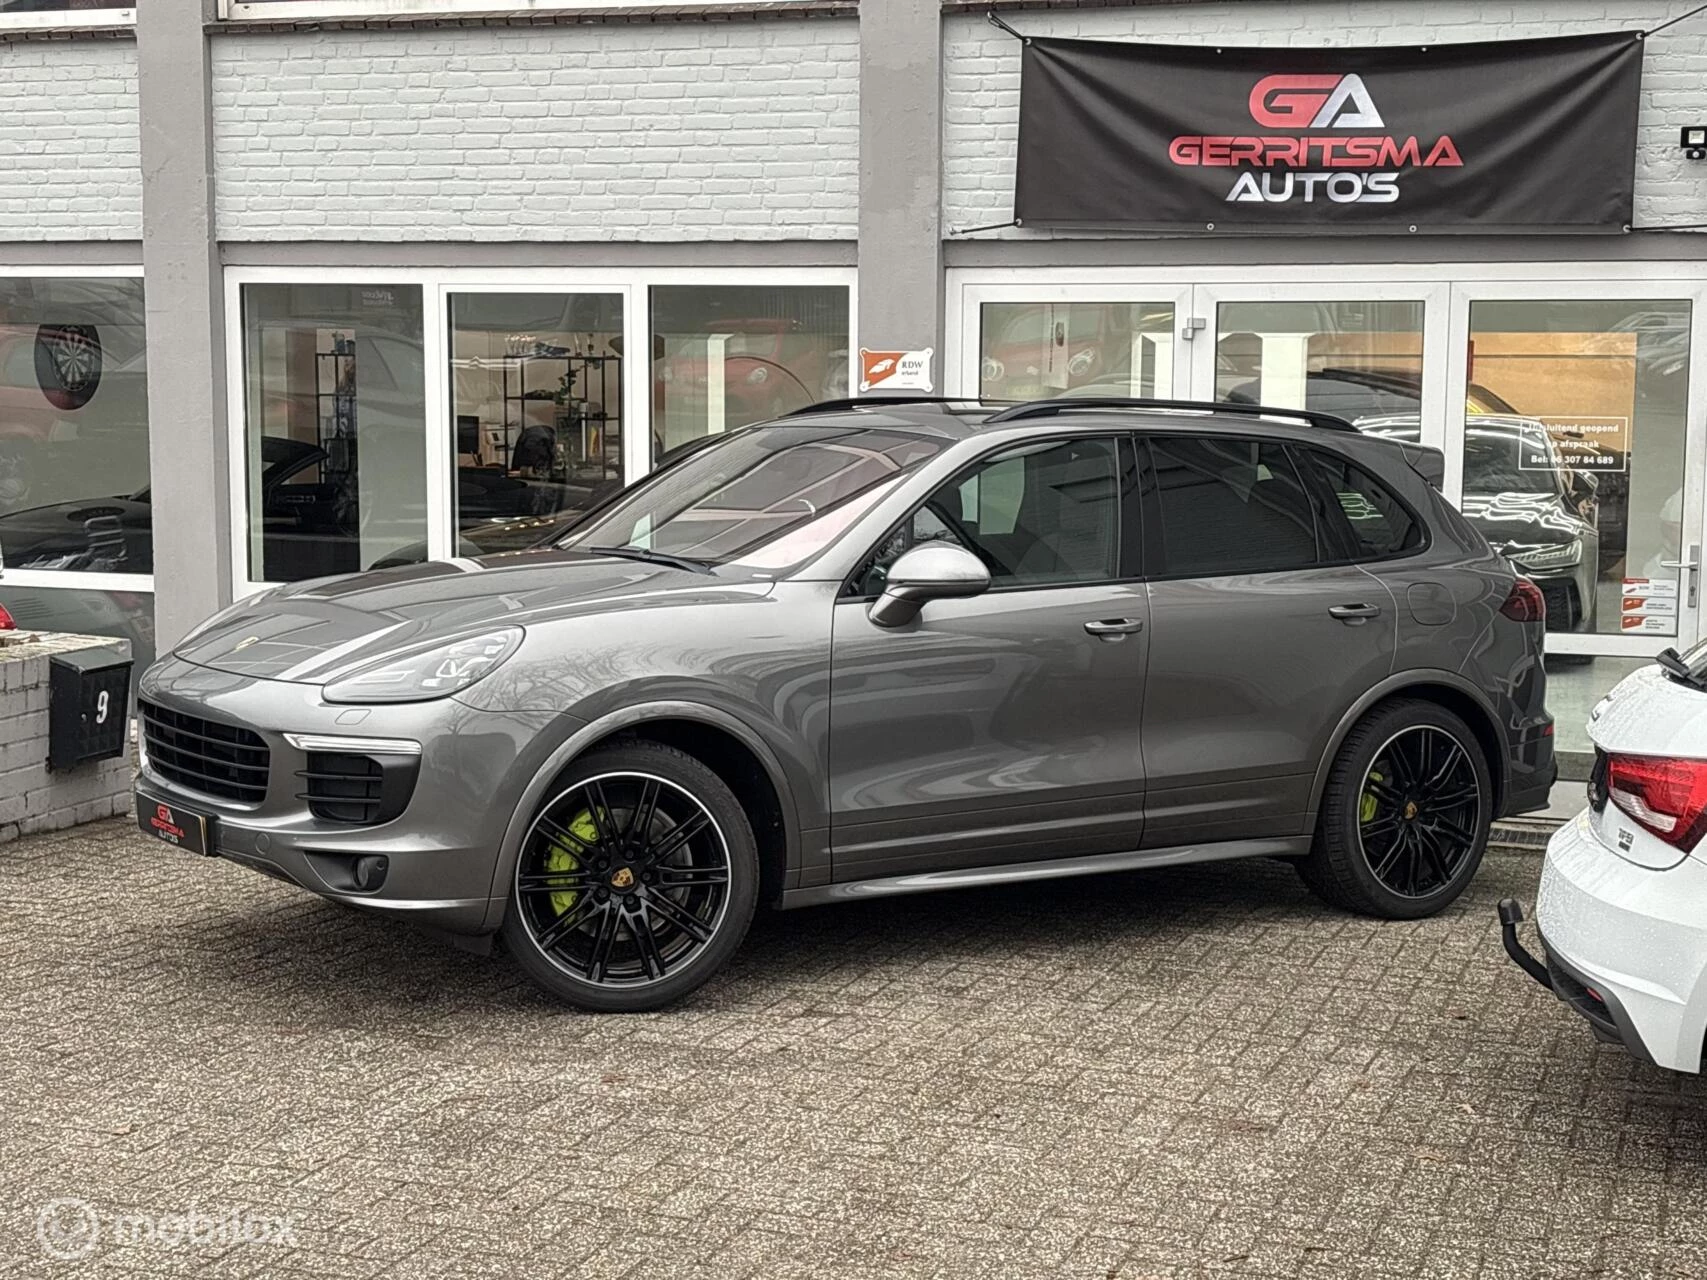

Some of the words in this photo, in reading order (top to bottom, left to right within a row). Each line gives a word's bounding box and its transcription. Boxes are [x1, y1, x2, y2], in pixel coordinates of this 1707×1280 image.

[1249, 73, 1384, 128] GA
[1168, 135, 1464, 167] GERRITSMA
[1225, 172, 1400, 203] AUTO'S
[901, 361, 924, 369] RDW
[1580, 424, 1619, 434] geopend
[1560, 440, 1600, 449] afspraak
[1531, 455, 1548, 463] Bel:
[1564, 456, 1581, 464] 307
[1583, 456, 1594, 464] 84
[1597, 456, 1614, 464] 689
[96, 690, 109, 724] 9
[157, 804, 175, 824] GA
